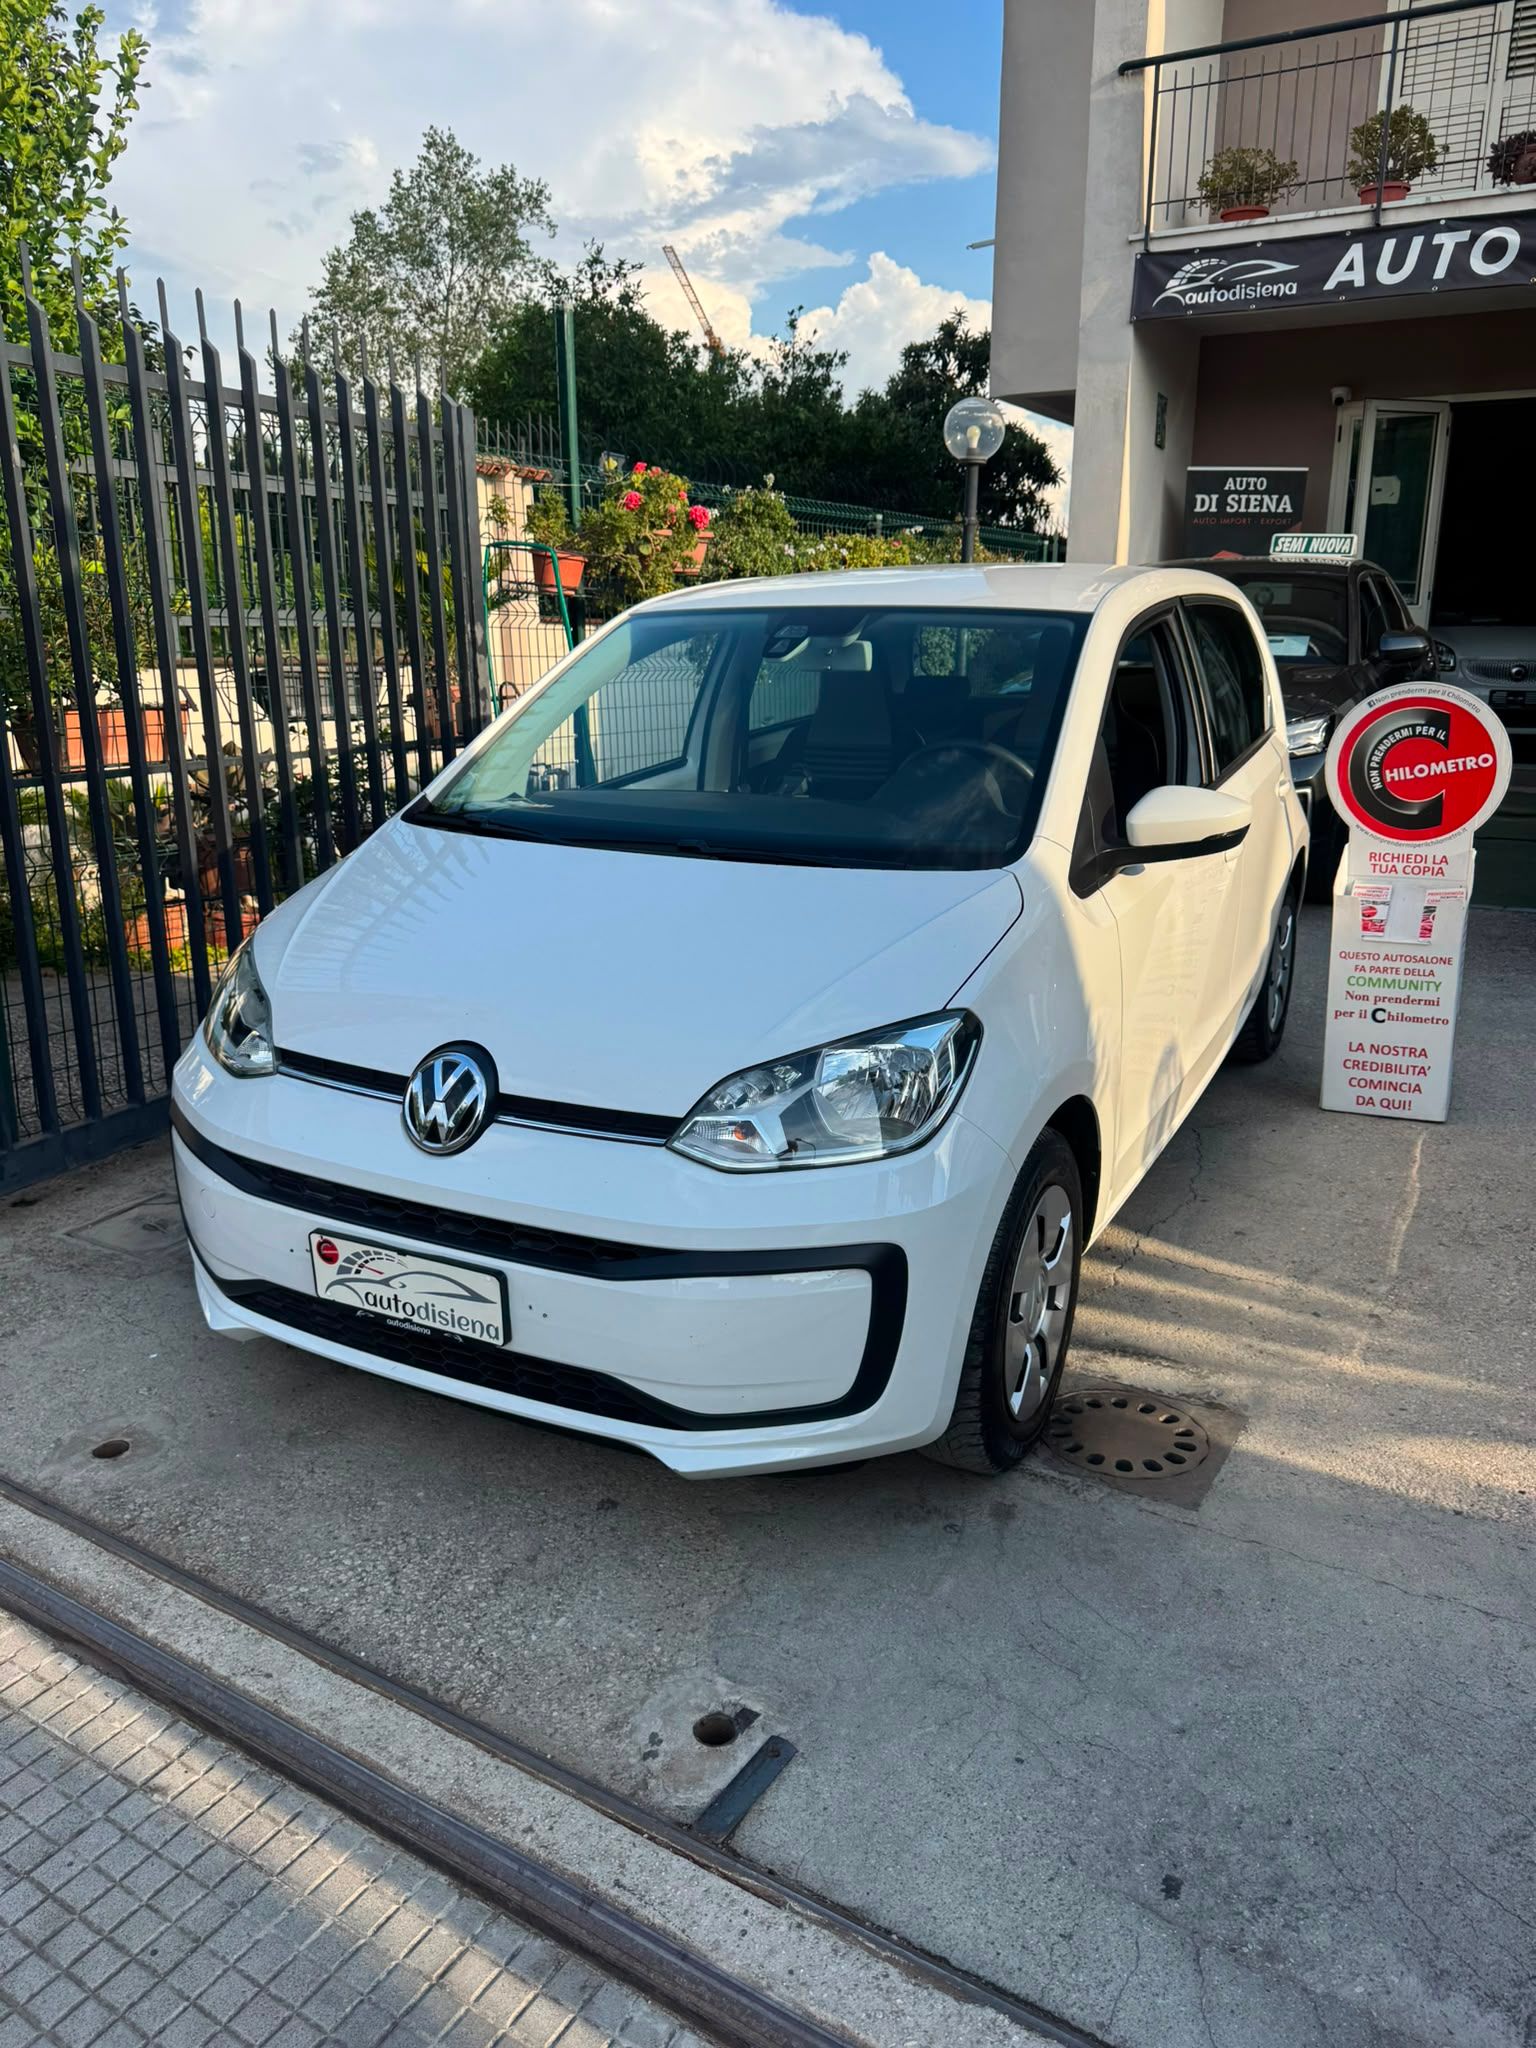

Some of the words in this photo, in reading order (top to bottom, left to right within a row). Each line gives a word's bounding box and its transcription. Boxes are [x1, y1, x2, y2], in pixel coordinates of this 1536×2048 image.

[1322, 226, 1521, 291] AUTO
[1185, 281, 1298, 305] autodisiena
[1224, 477, 1267, 491] AUTO
[1194, 494, 1219, 513] DI
[1226, 494, 1293, 514] SIENA
[1275, 536, 1307, 552] SEMI
[1309, 537, 1351, 553] NUOVA
[1415, 725, 1436, 737] PER
[1436, 729, 1448, 741] IL
[1370, 727, 1413, 768] PRENDERMI
[1370, 770, 1383, 790] NON
[1368, 852, 1428, 865] RICHIEDI
[1432, 854, 1449, 866] LA
[1370, 863, 1398, 875] TUA
[1402, 865, 1446, 877] COPIA
[1339, 951, 1381, 961] QUESTO
[1383, 953, 1453, 966] AUTOSALONE
[1354, 965, 1367, 974] FA
[1369, 966, 1401, 976] PARTE
[1403, 968, 1436, 978] DELLA
[1347, 975, 1442, 992] COMMUNITY
[1344, 990, 1370, 1002] Non
[1373, 993, 1441, 1007] prendermi
[1334, 1009, 1356, 1019] per
[1358, 1009, 1367, 1019] il
[1371, 1007, 1450, 1026] Chilometro
[1348, 1041, 1366, 1054] LA
[1370, 1043, 1429, 1059] NOSTRA
[1342, 1058, 1432, 1077] CREDIBILITA'
[1348, 1076, 1423, 1094] COMINCIA
[1355, 1095, 1376, 1108] DA
[1379, 1097, 1413, 1111] QUI!
[364, 1290, 500, 1341] autodisiena
[386, 1317, 431, 1335] autodisiena
